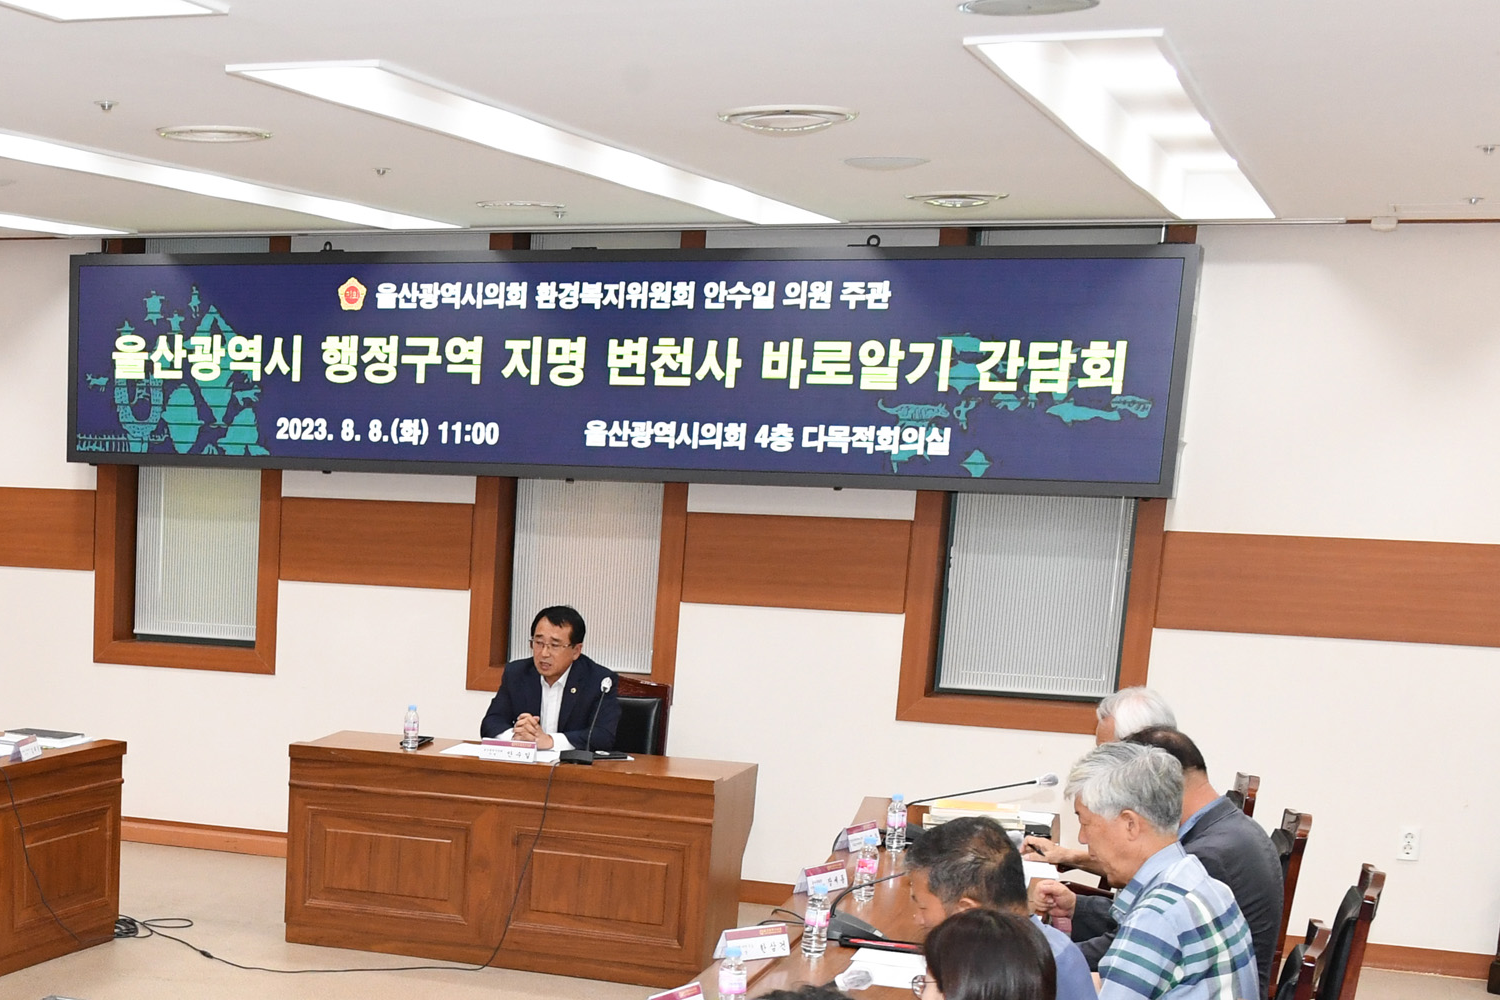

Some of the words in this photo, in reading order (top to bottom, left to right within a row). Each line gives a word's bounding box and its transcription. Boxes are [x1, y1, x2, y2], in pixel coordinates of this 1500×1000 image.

[375, 280, 528, 310] 울산광역시의회
[535, 280, 695, 310] 환경복지위원회
[703, 280, 775, 309] 안수일
[782, 281, 832, 309] 의원
[839, 281, 892, 310] 주관
[111, 334, 302, 382] 울산광역시
[321, 335, 483, 385] 행정구역
[501, 336, 587, 387] 지명
[607, 336, 742, 389] 변천사
[761, 337, 953, 392] 바로알기
[975, 339, 1128, 395] 간담회
[275, 416, 334, 441] 2023.
[340, 418, 361, 442] 8.
[368, 417, 429, 446] 8.(화)
[437, 421, 500, 446] 11:00
[583, 419, 748, 451] 울산광역시의회
[754, 423, 795, 453] 4층
[801, 424, 952, 456] 다목적회의실
